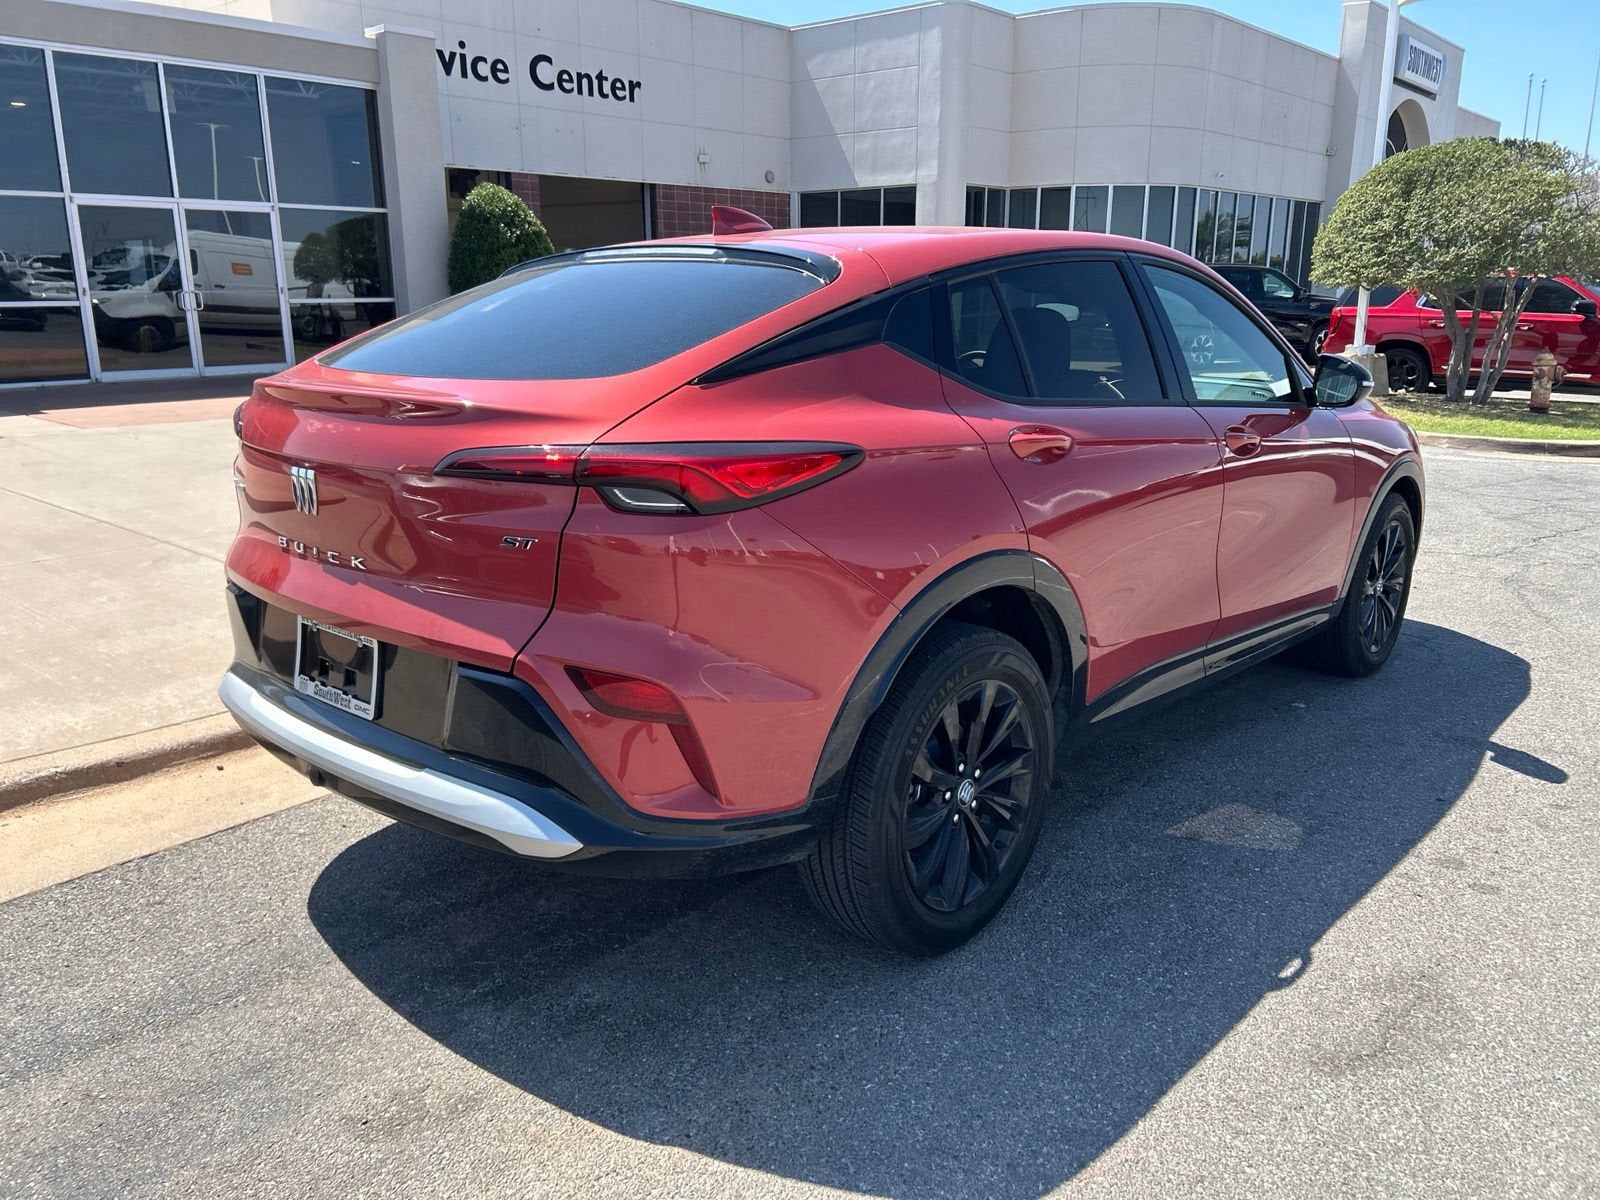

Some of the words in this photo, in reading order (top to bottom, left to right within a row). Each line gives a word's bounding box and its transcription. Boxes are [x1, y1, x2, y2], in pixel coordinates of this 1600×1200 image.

[529, 54, 642, 103] Center
[1407, 44, 1442, 84] SOUTHWEST
[277, 535, 367, 570] BUICK
[499, 535, 539, 550] ST
